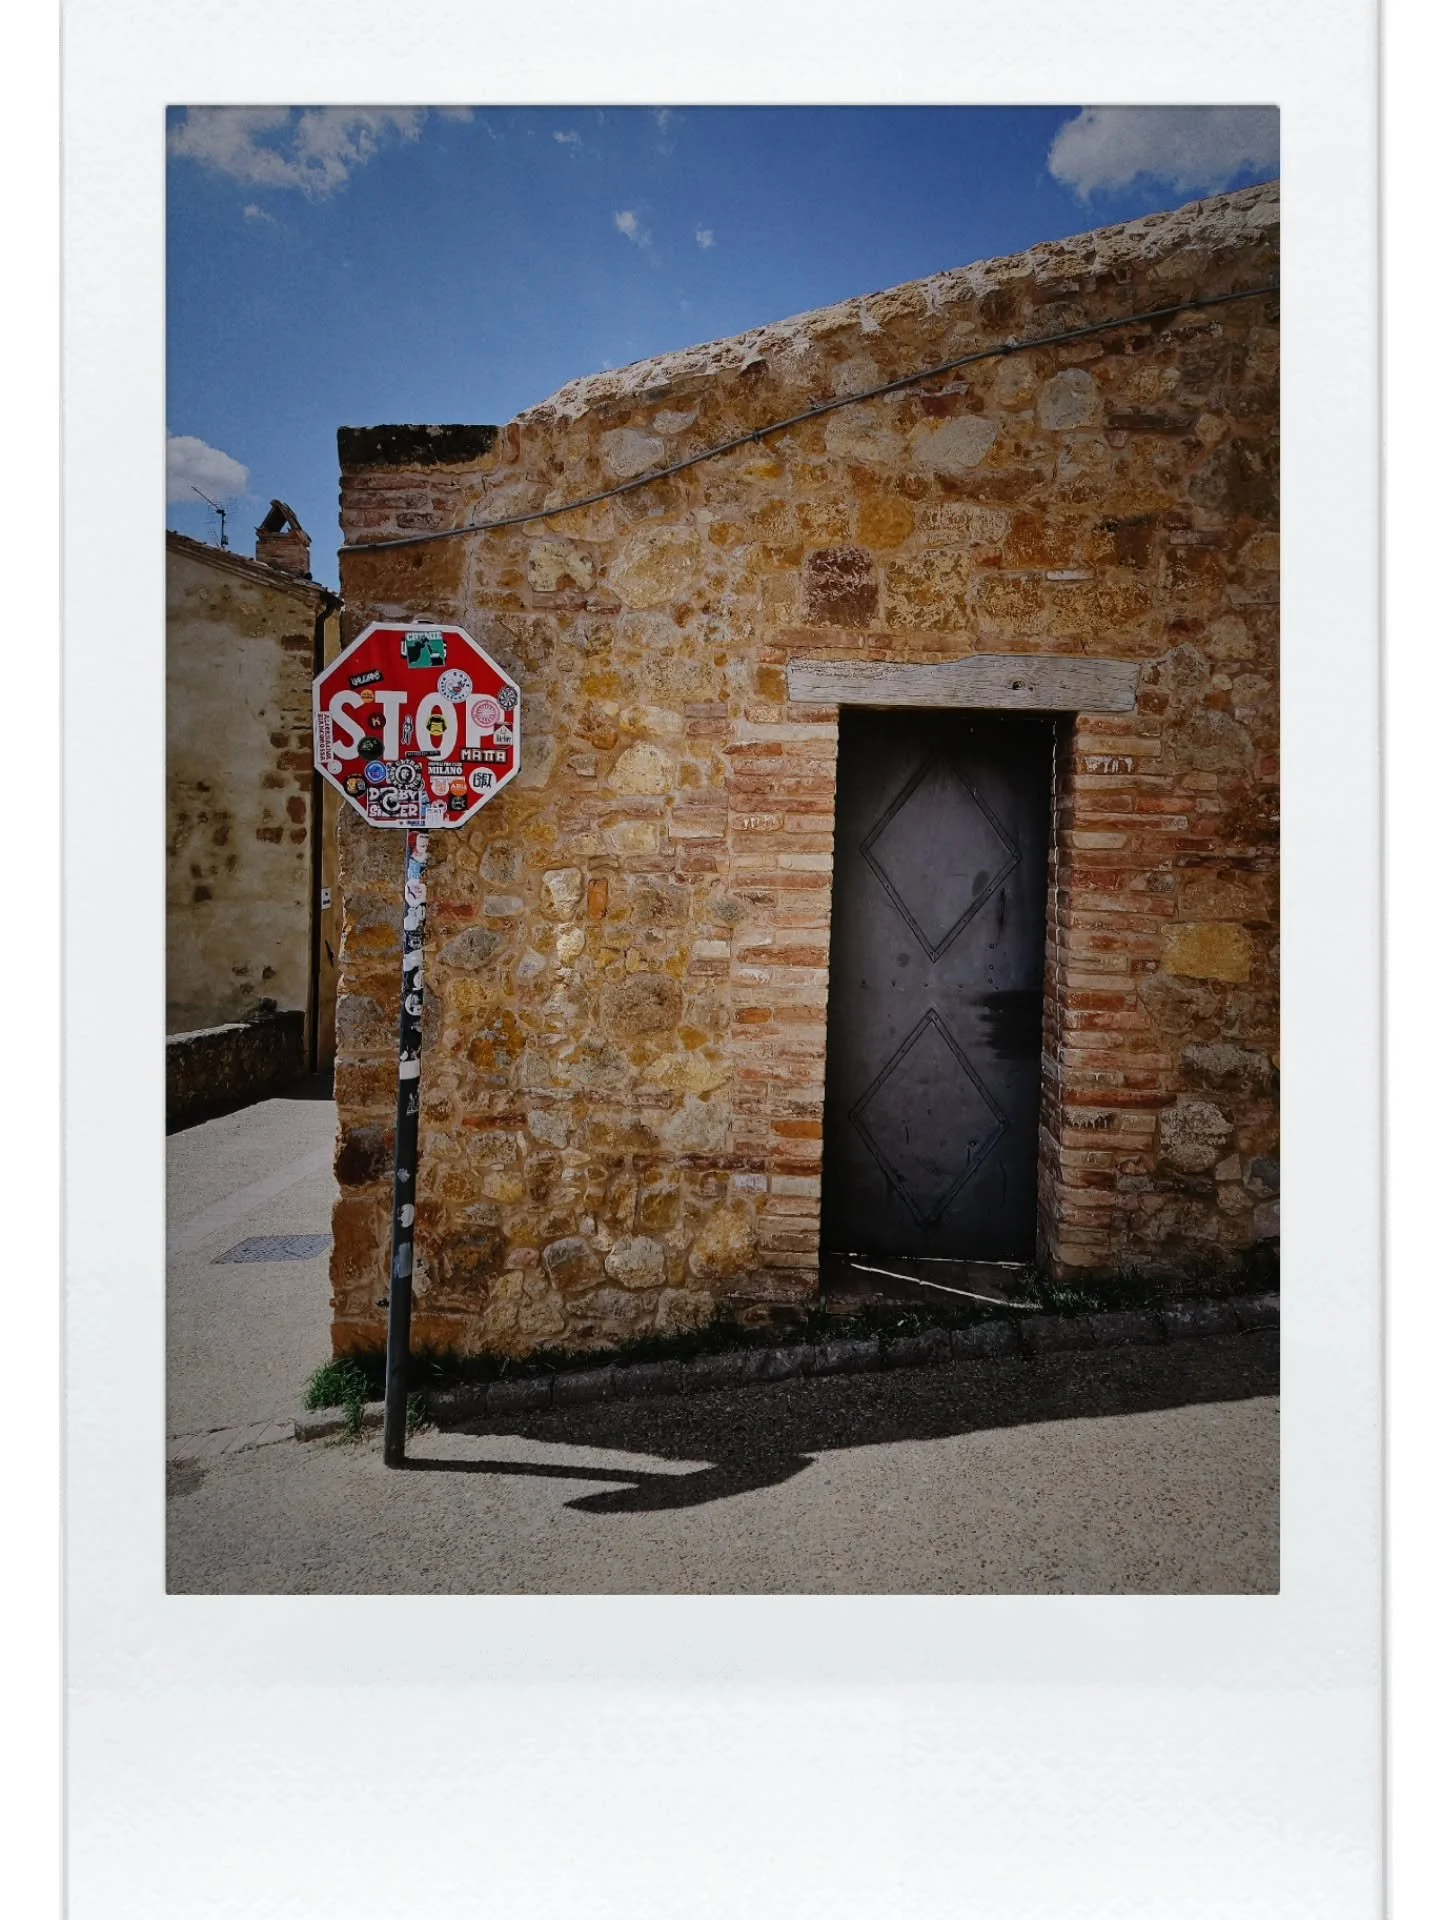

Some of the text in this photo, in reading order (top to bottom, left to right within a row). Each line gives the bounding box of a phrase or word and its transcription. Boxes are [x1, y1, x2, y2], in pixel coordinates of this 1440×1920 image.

[329, 690, 505, 761] STOP
[461, 749, 506, 762] MATTA
[427, 766, 463, 775] MILANO
[368, 787, 417, 801] DBY
